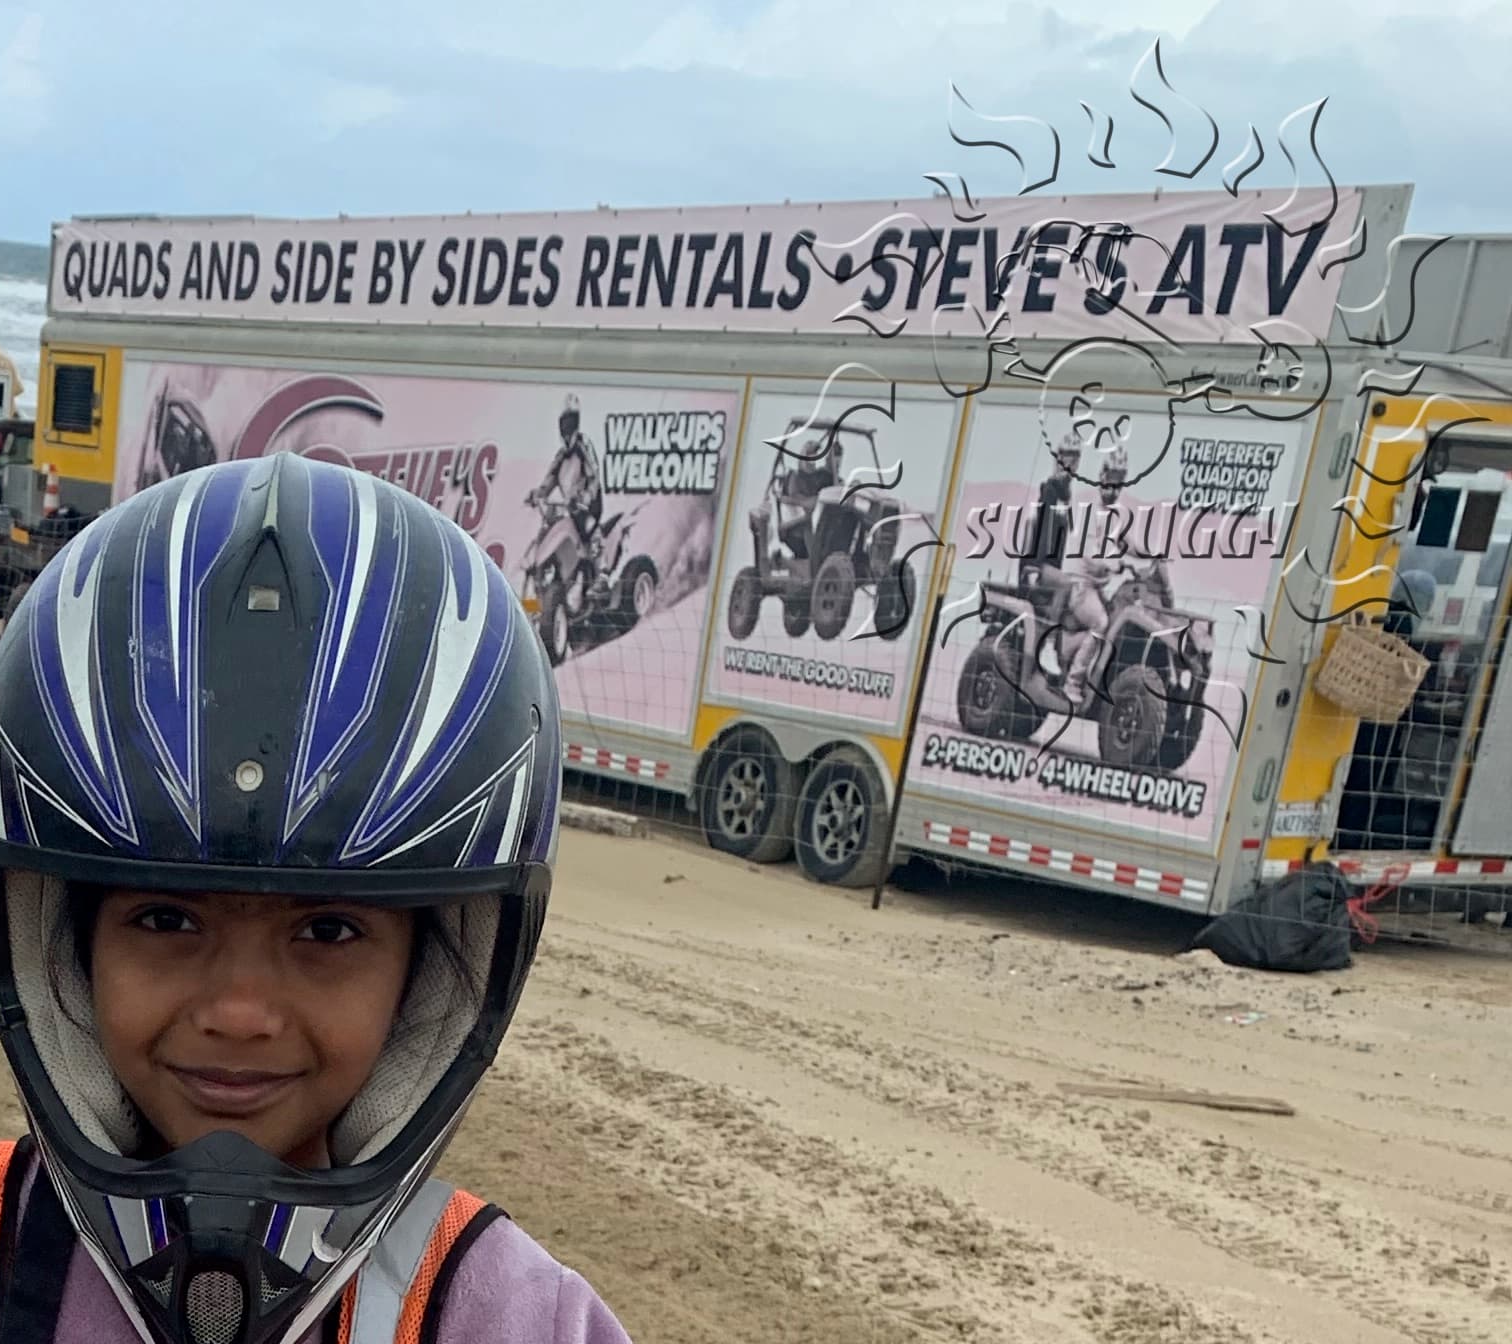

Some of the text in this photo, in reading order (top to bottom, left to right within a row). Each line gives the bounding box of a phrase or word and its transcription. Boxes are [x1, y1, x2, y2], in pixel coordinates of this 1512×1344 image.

[63, 222, 1329, 316] QUADS AND SIDE BY SIDES RENTALS STEVE'S ATV
[606, 411, 726, 452] WALK-UPS
[604, 452, 719, 493] WELCOME
[1181, 439, 1286, 469] THE PERFECT
[1181, 464, 1273, 491] QUAD FOR
[725, 647, 745, 671] WE
[745, 650, 778, 677] RENT
[778, 655, 804, 681] THE
[804, 660, 848, 690] GOOD
[924, 735, 1207, 818] 2-PERSON 4-WHEEL DRIVE
